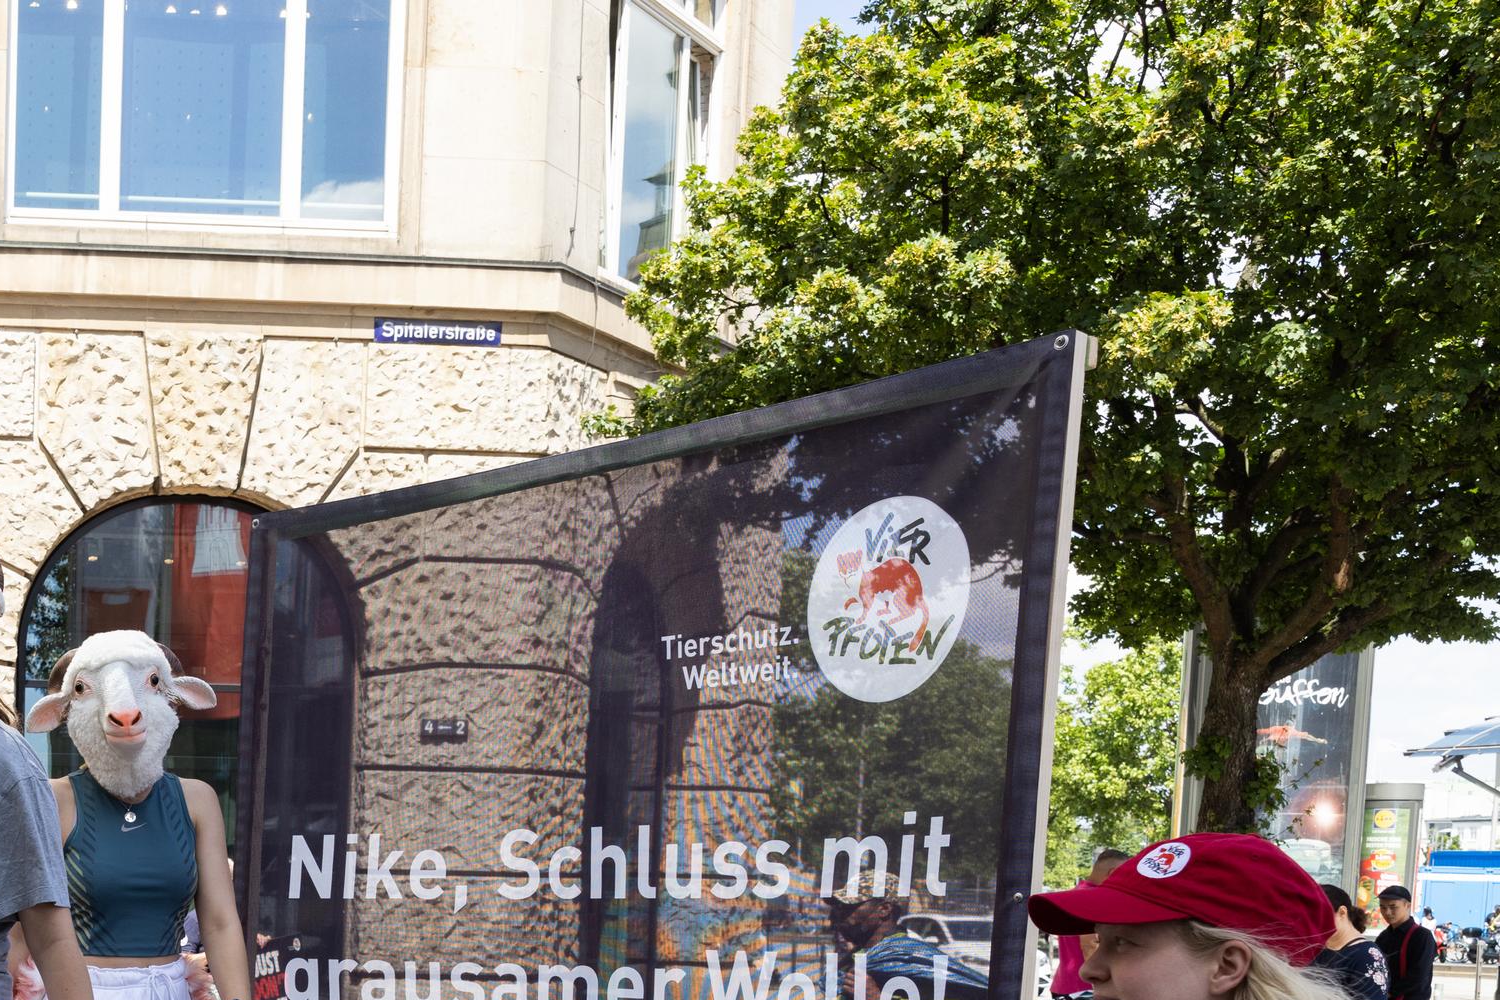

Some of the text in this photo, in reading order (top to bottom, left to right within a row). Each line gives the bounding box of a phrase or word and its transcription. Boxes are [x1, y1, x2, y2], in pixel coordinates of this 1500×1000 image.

[382, 321, 496, 341] Spitalerstraße
[661, 625, 799, 660] Tierschutz.
[682, 655, 799, 690] Weltweit.
[424, 720, 465, 735] 4 2
[288, 811, 950, 914] Nike, Schluss mit
